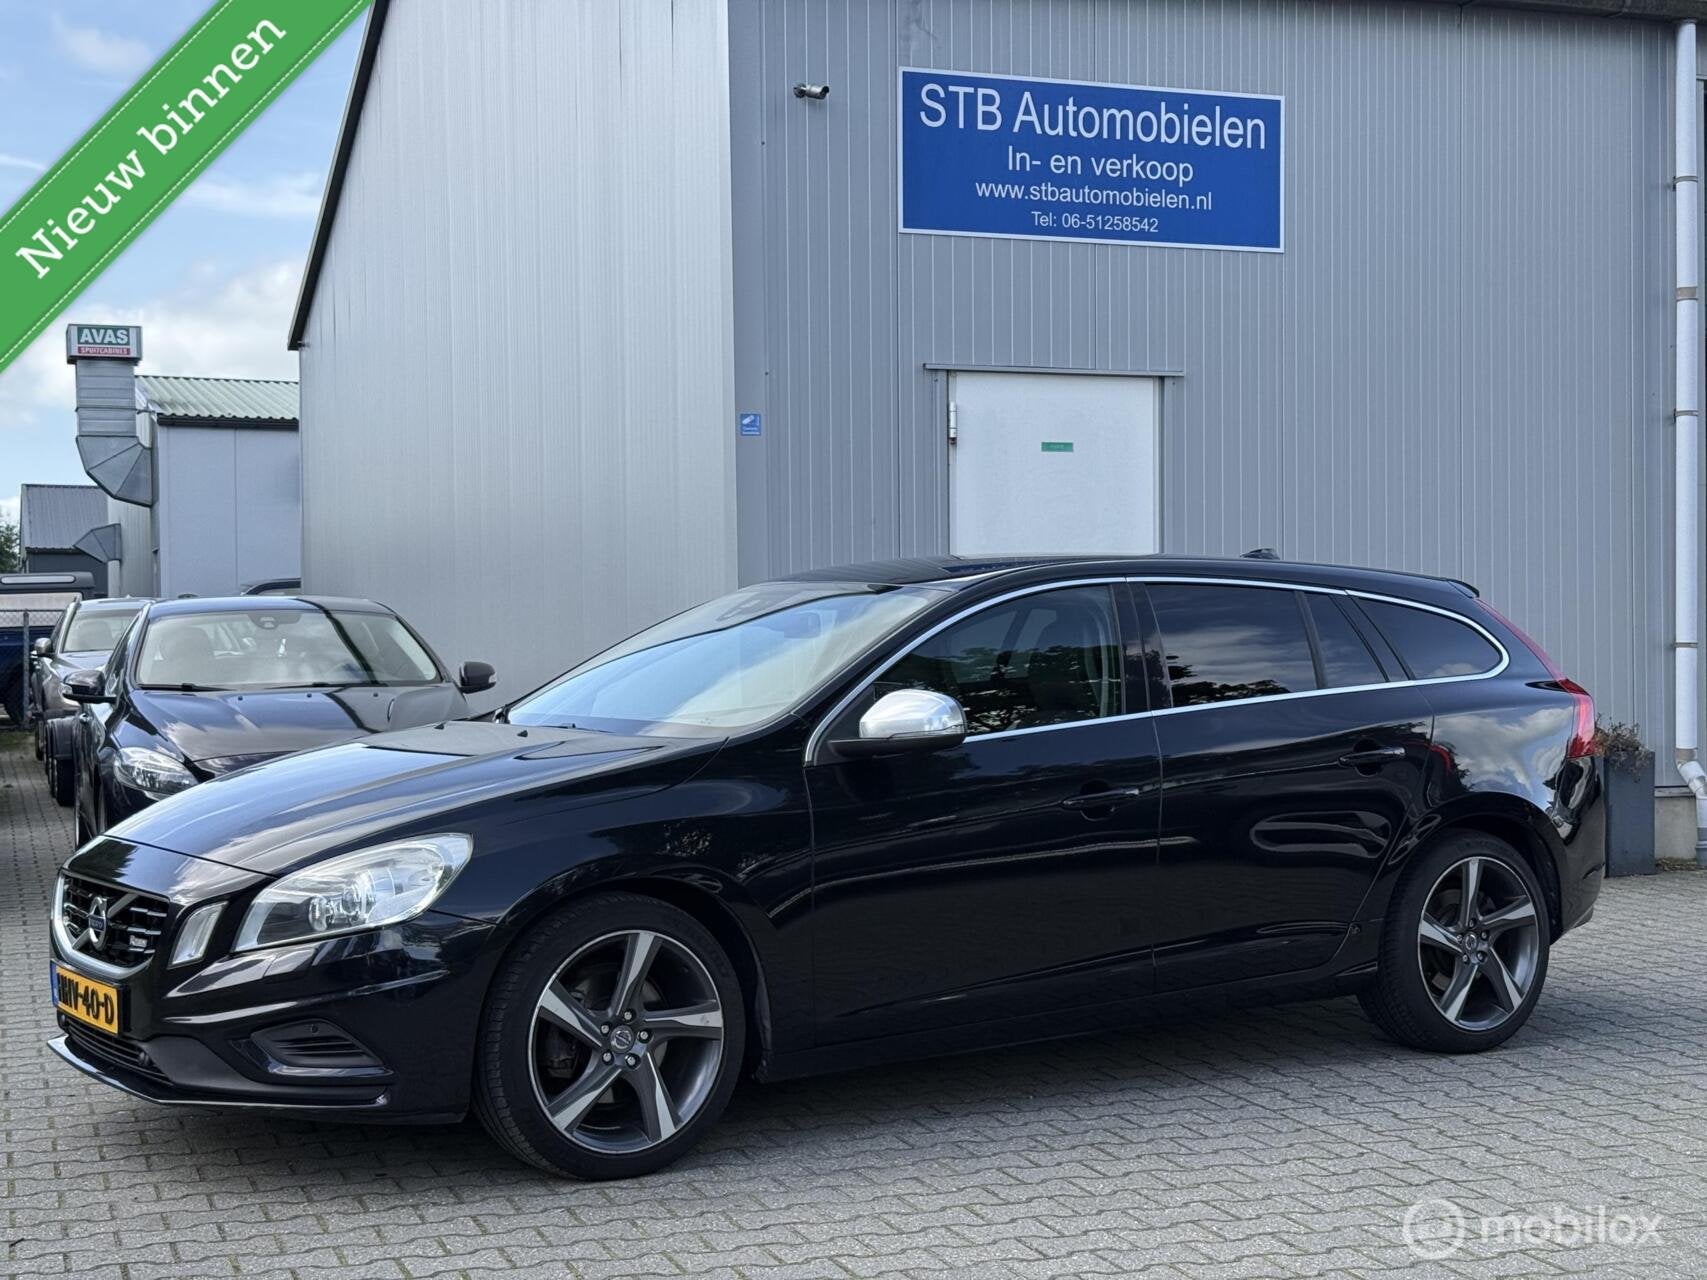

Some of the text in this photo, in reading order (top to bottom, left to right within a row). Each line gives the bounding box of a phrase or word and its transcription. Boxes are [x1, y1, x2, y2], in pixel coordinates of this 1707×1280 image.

[920, 83, 1265, 149] STB Automobielen
[1008, 145, 1193, 187] In- en verkoop
[975, 181, 1212, 211] www.stbautomobielen.nl
[1031, 211, 1159, 233] Tel: 06-51258542
[80, 328, 128, 344] AVAS
